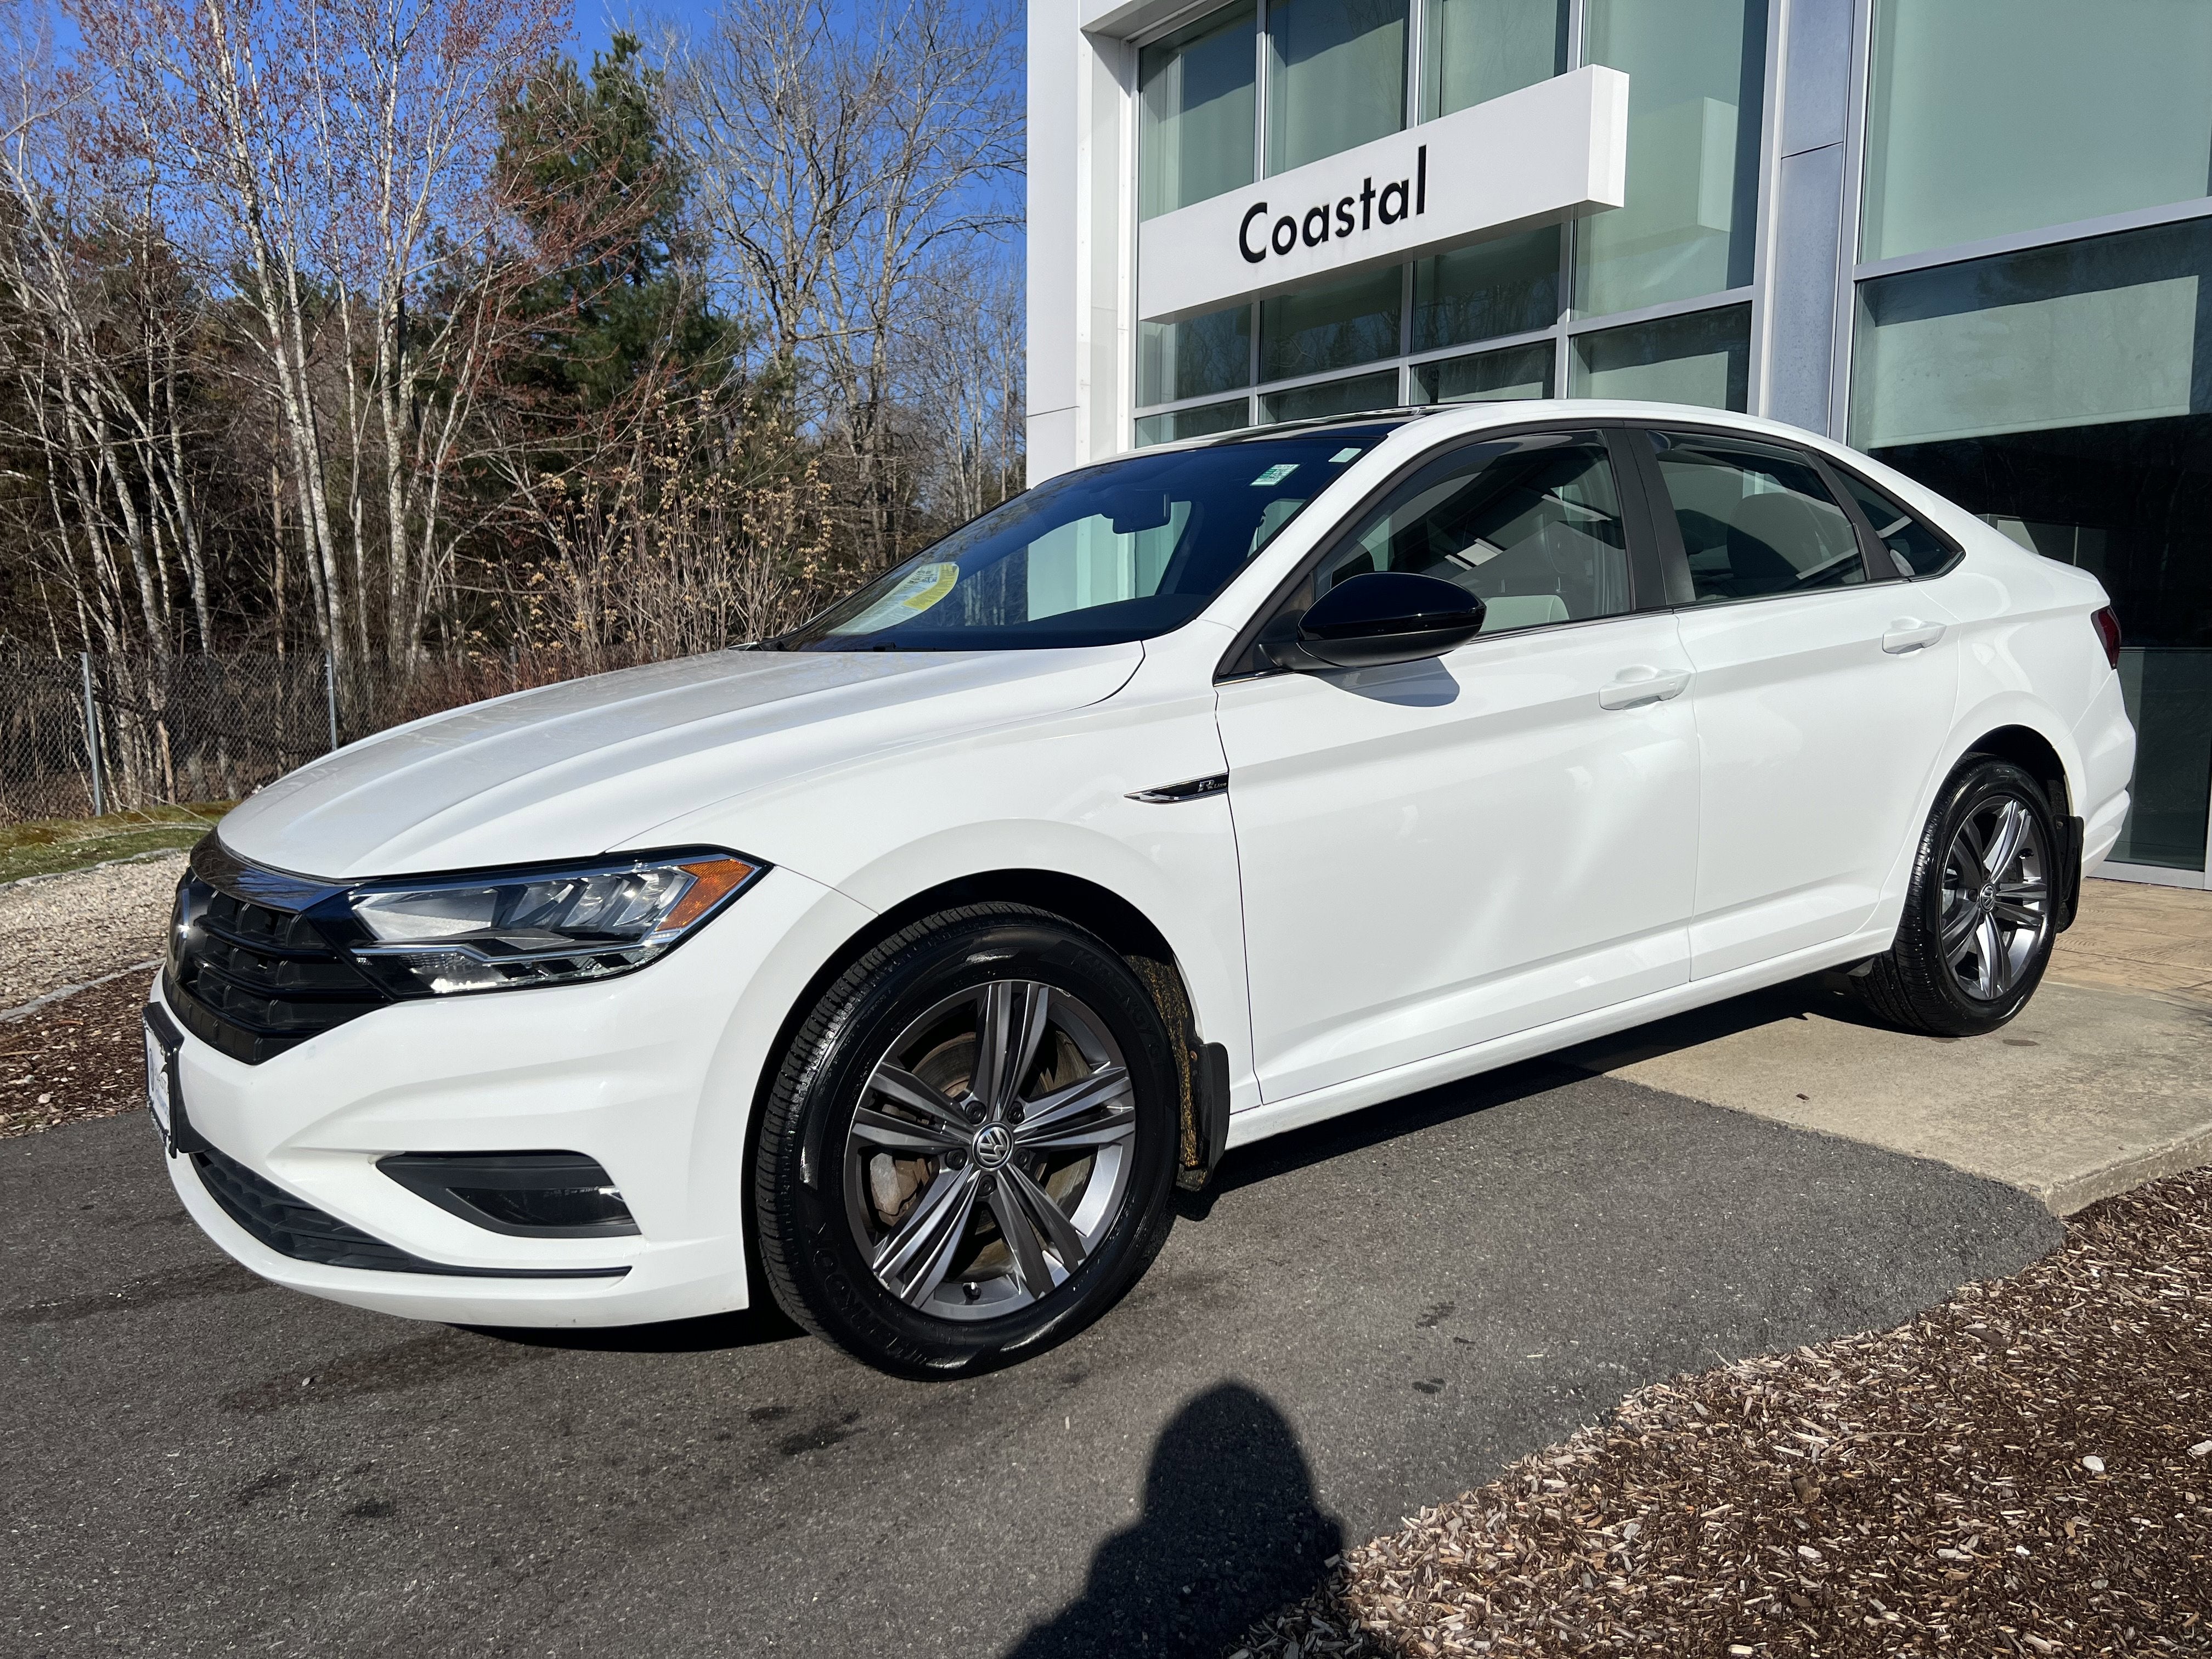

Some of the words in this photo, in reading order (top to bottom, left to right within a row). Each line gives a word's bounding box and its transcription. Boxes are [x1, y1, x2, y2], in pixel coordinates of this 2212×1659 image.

[1239, 144, 1427, 264] Coastal
[1198, 780, 1214, 792] R
[976, 1126, 1010, 1166] VW
